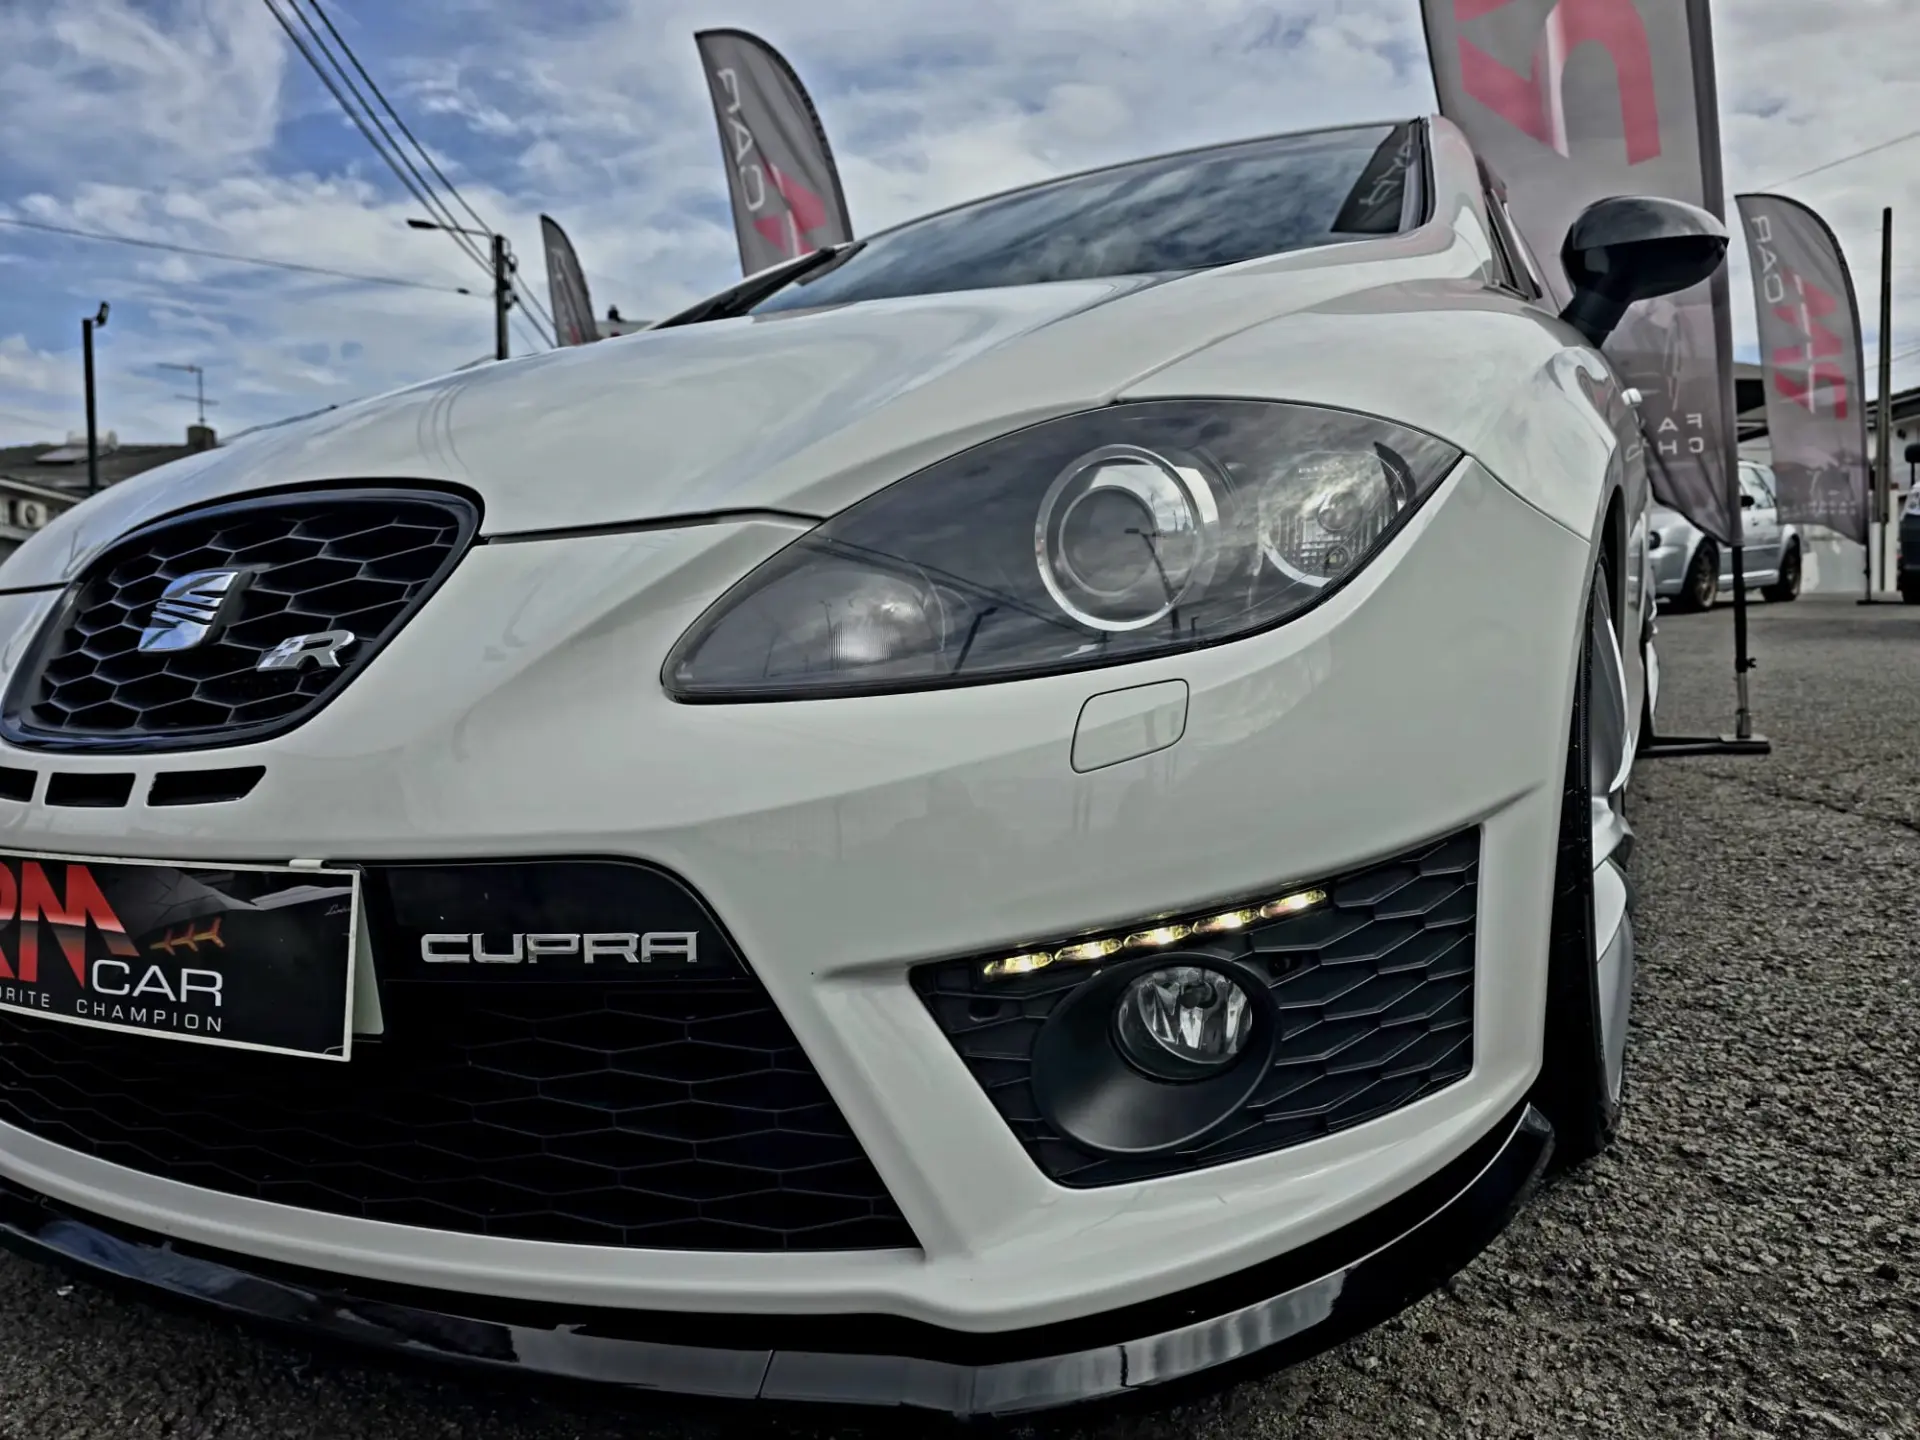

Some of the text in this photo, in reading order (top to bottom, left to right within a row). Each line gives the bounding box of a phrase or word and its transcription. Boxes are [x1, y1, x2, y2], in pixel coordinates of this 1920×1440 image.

[420, 930, 699, 965] CUPRA
[92, 959, 224, 1007] CAR
[0, 985, 223, 1033] RITE CHAMPION
